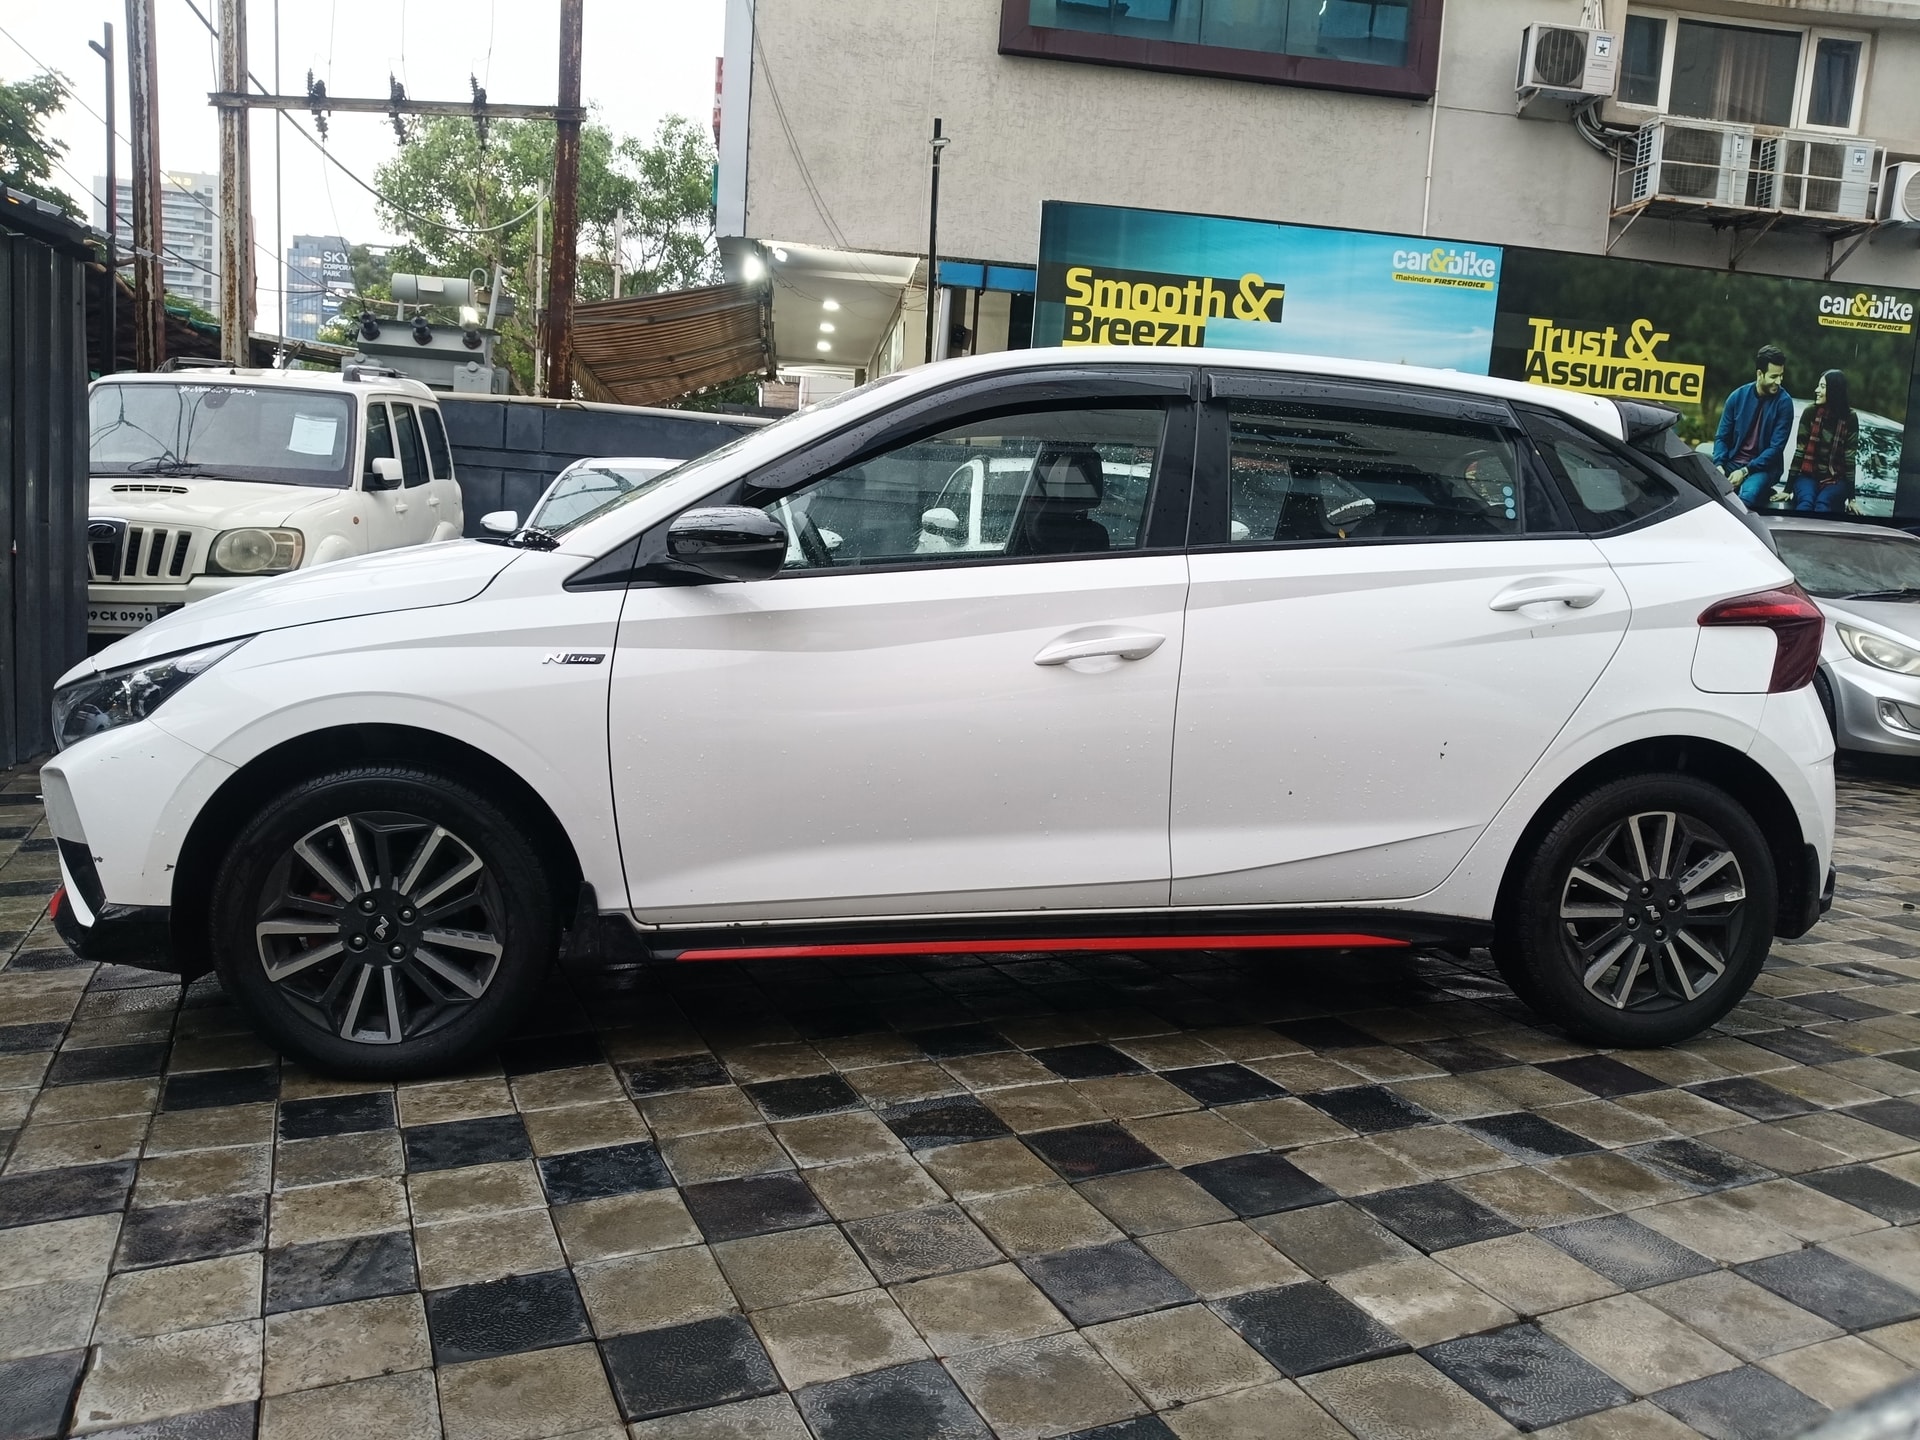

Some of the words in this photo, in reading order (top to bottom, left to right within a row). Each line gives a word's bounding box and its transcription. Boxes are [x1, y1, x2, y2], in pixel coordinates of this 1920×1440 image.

[323, 251, 350, 263] SKY
[1392, 248, 1496, 278] car&bike
[1395, 274, 1432, 283] Mahindra
[1433, 277, 1457, 286] FIRST
[1457, 280, 1486, 289] CHOICE
[1065, 267, 1226, 318] Smooth
[1231, 273, 1285, 322] &
[1819, 293, 1914, 321] car&bike
[1821, 318, 1855, 327] Mahindra
[1855, 321, 1877, 329] FIRST
[1877, 323, 1904, 331] CHOICE
[1528, 317, 1618, 358] Trust
[1624, 318, 1670, 361] &
[1524, 350, 1700, 397] Assurance
[87, 611, 98, 621] 9
[100, 611, 118, 621] CK
[120, 611, 153, 622] 0990
[542, 652, 567, 664] N
